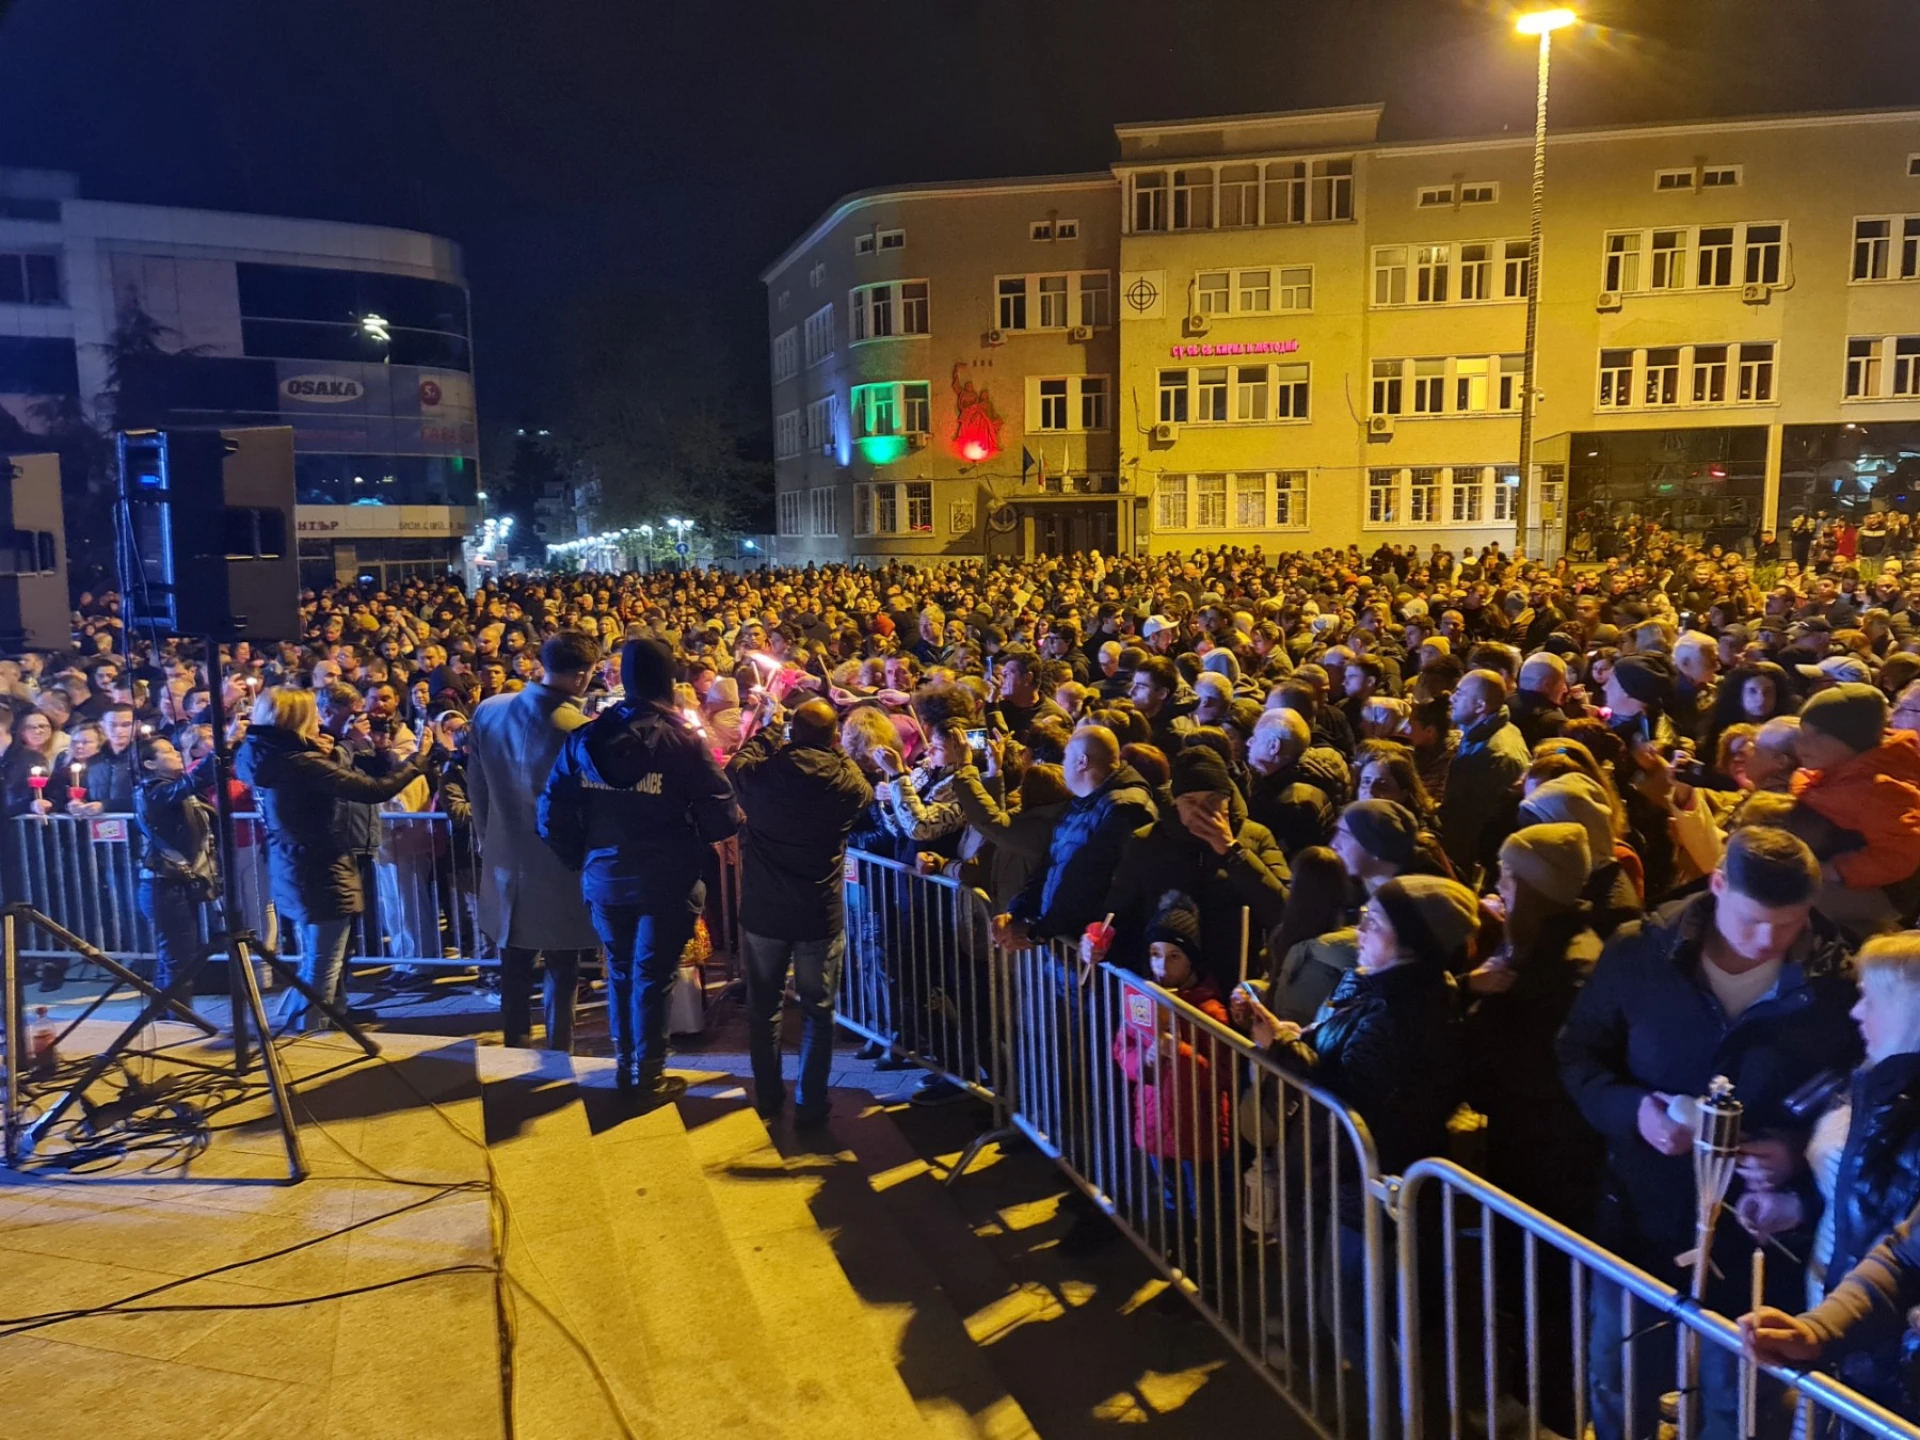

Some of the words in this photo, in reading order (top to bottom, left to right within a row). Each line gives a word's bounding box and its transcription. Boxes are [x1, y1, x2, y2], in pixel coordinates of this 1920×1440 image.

[288, 381, 358, 396] OSAKA
[298, 521, 339, 531] НТЪР
[629, 773, 663, 794] OLICE
